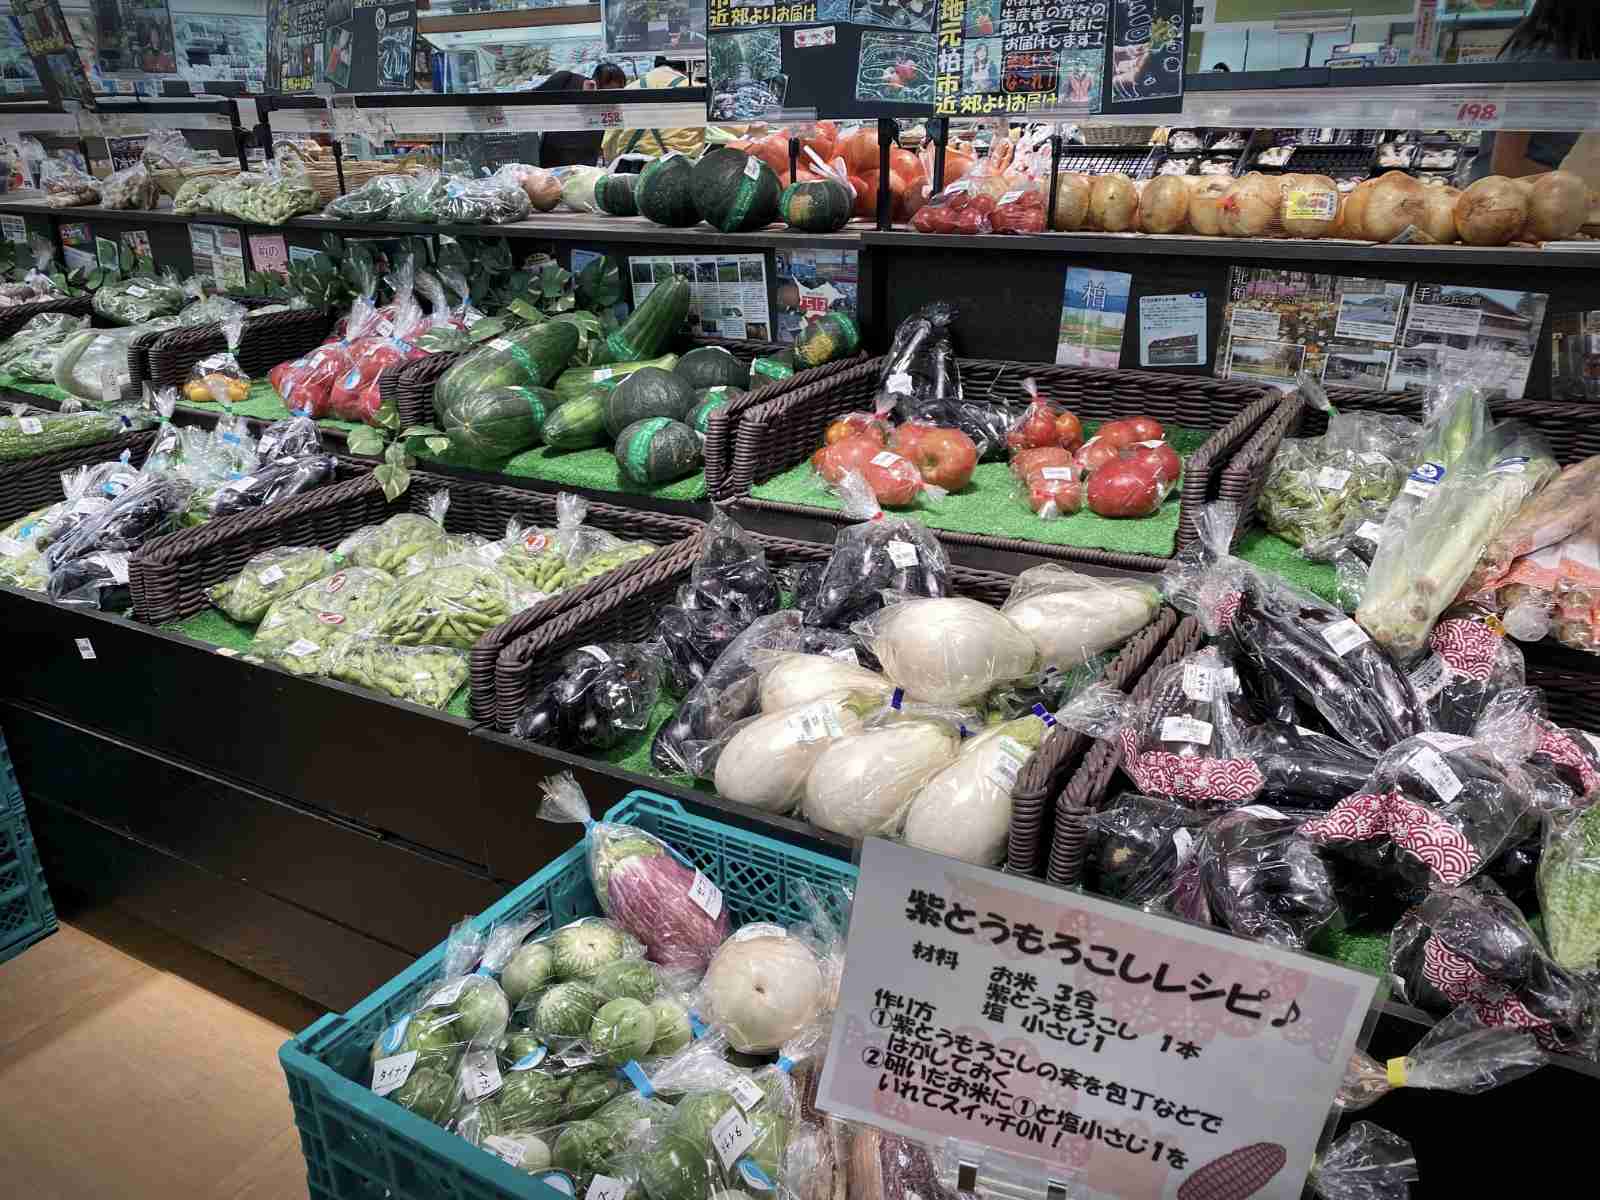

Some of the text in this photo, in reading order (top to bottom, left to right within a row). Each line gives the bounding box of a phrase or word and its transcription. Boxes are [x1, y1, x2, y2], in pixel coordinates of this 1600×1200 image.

[1001, 3, 1106, 20] 生産者の方々の
[1456, 103, 1497, 120] 198
[1080, 279, 1107, 310] 柏
[911, 940, 959, 970] 材料
[874, 988, 936, 1022] 作り方
[989, 966, 1098, 1011] お米 3合
[981, 1000, 1107, 1053] 塩 小さじ1
[985, 982, 1203, 1060] 紫とうもろこし 1本
[887, 1033, 1010, 1089] はがしておく
